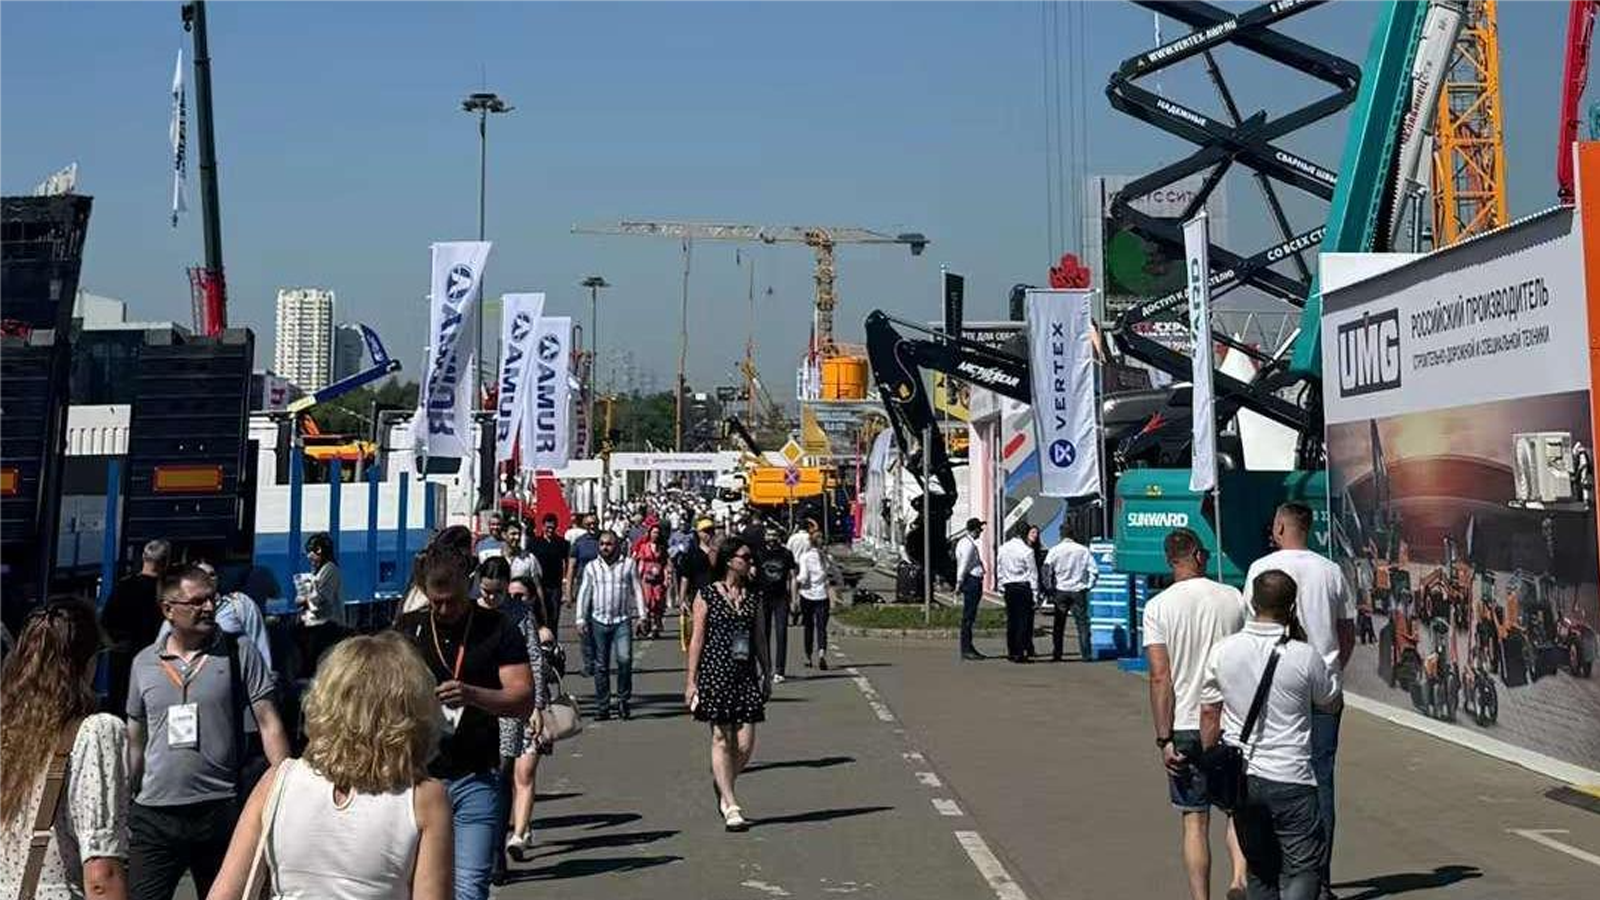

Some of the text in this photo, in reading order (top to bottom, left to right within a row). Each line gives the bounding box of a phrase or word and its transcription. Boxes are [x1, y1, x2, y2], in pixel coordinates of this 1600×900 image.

[1157, 99, 1206, 126] НАДЕЖНЫЕ
[1276, 151, 1316, 175] СВАРНЫЕ
[1284, 236, 1310, 256] ВСЕХ
[1411, 277, 1549, 339] РОССИЙСКИЙ ПРОИЗВОДИТЕЛЬ
[1052, 322, 1067, 430] VERTEX
[1339, 319, 1399, 389] UMG
[499, 343, 523, 443] AMUR
[536, 360, 556, 453] AMUR
[1127, 512, 1189, 527] SUNWARD
